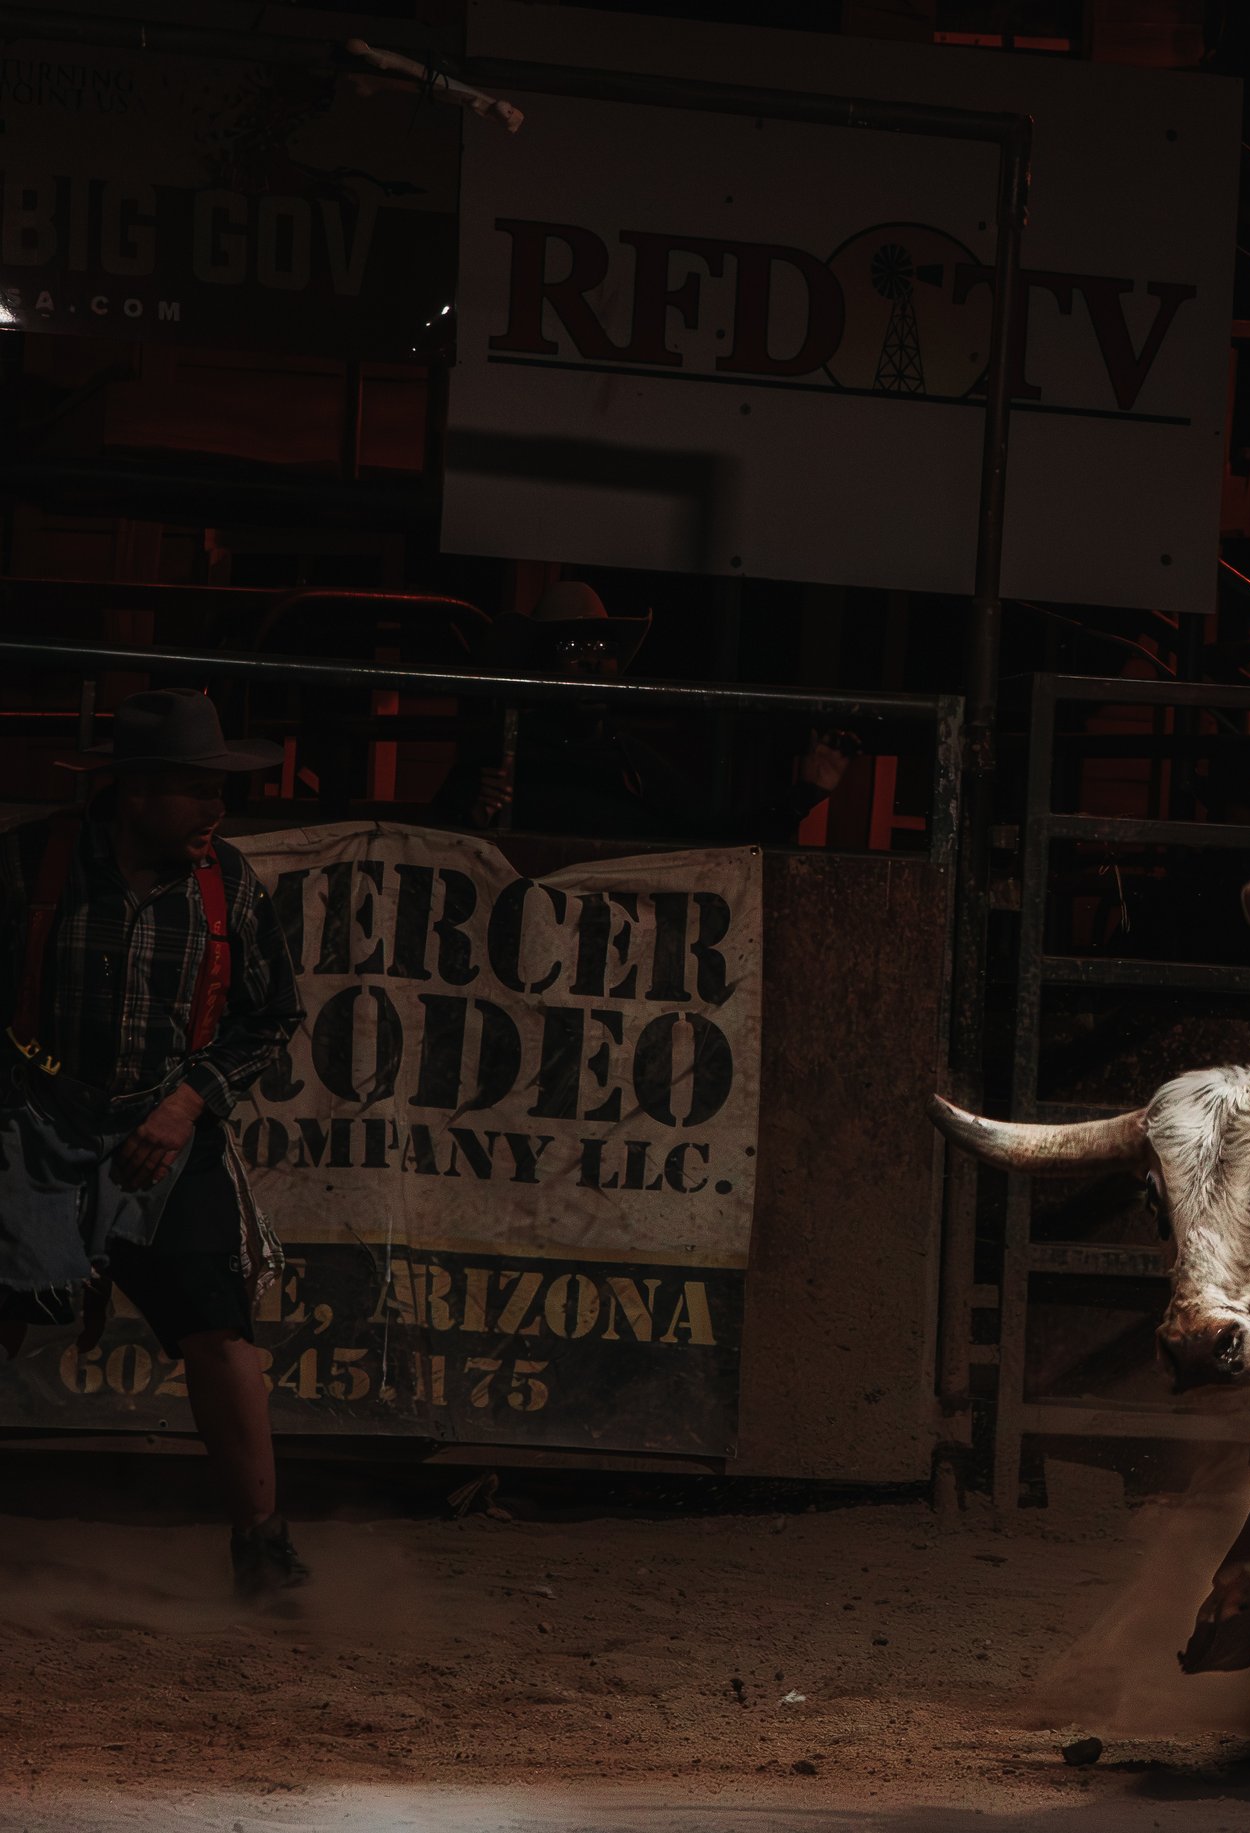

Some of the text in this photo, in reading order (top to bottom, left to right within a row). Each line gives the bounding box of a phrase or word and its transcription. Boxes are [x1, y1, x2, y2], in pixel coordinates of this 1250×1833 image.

[1, 172, 380, 297] BIG GOV
[488, 217, 1197, 411] RFD TV
[259, 985, 733, 1128] ODEO
[228, 1116, 733, 1194] OMPANY LLC.
[367, 1258, 718, 1346] ARIZONA
